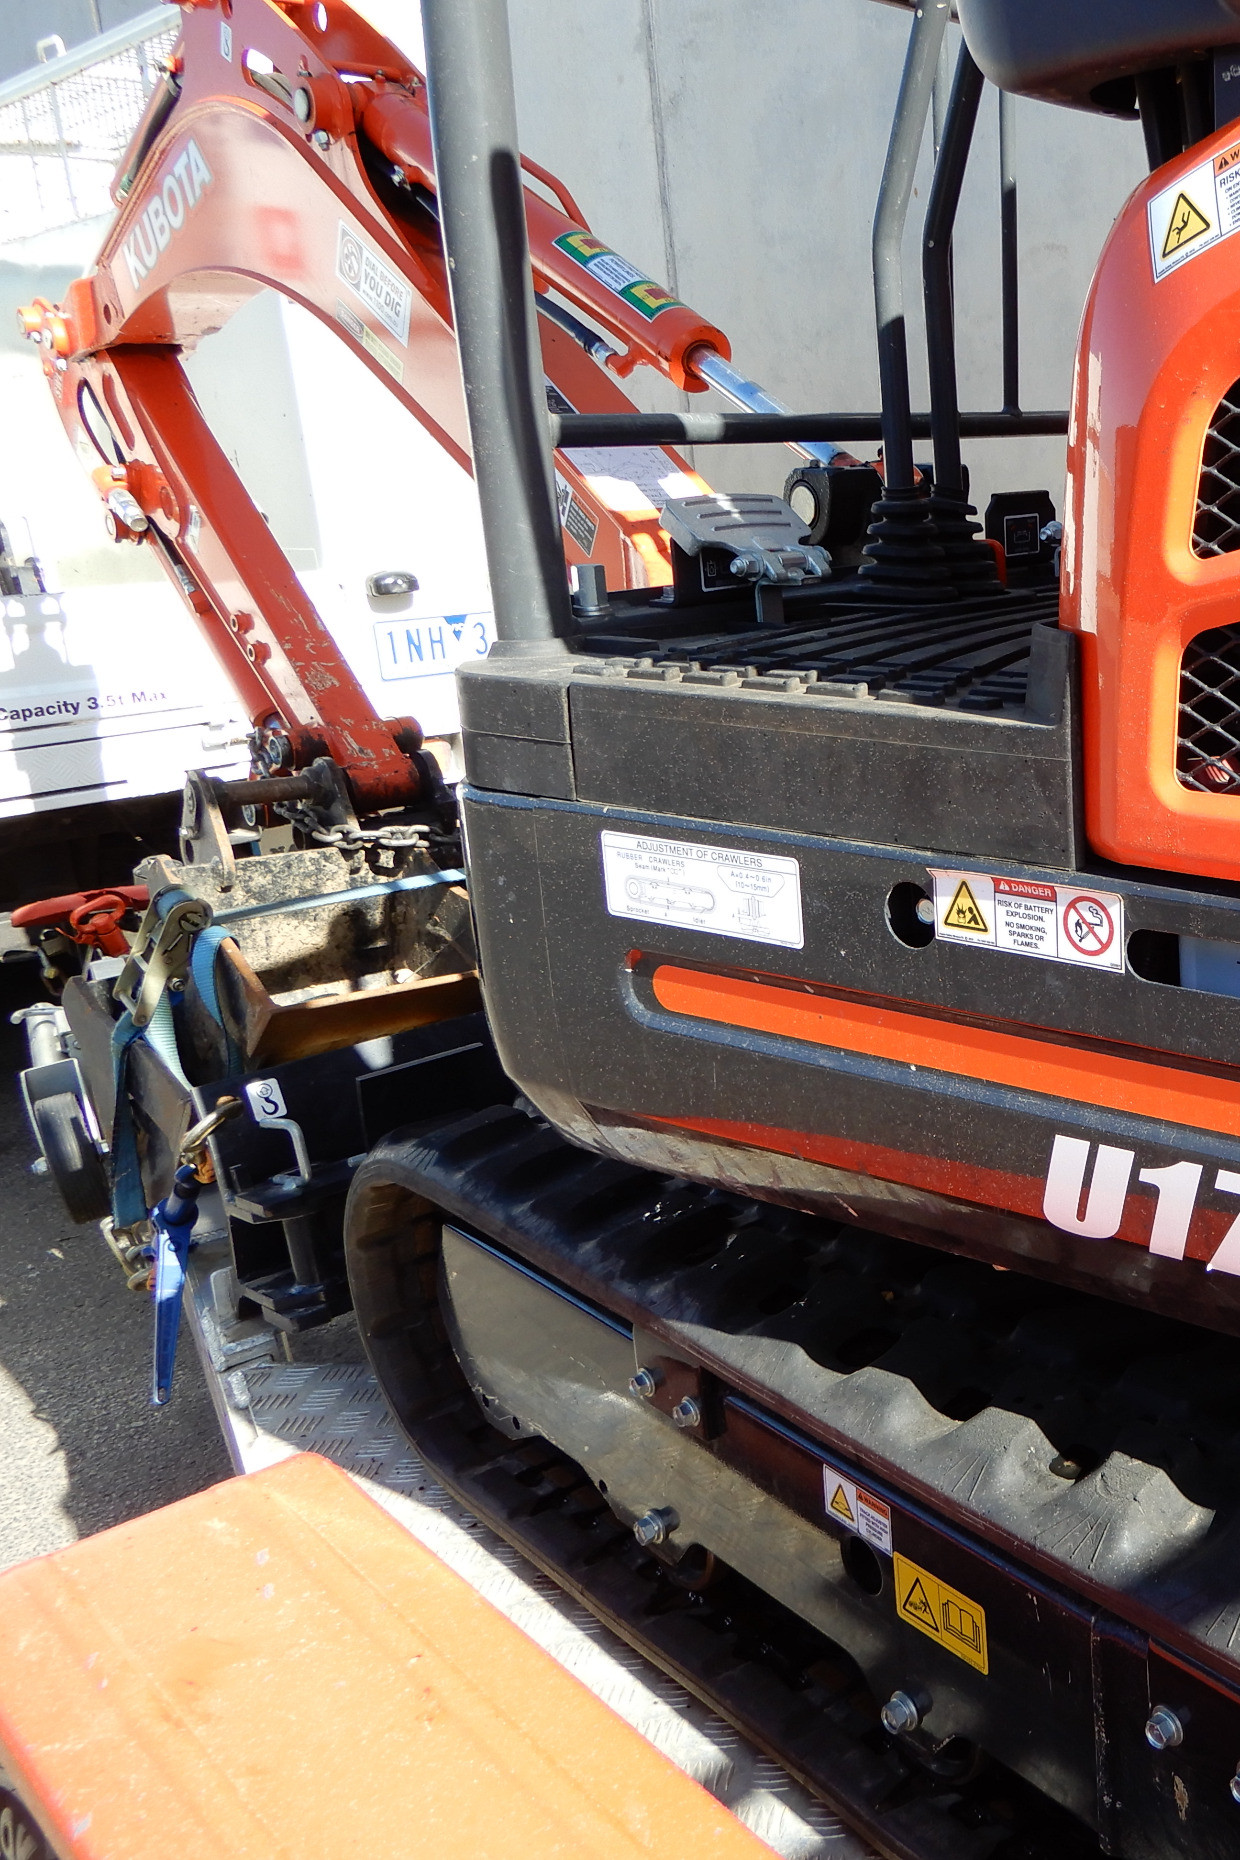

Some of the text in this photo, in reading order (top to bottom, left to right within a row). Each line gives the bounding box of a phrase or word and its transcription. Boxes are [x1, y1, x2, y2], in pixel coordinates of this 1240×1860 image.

[1220, 167, 1240, 188] RISK
[123, 137, 214, 292] KUBOTA
[365, 256, 404, 301] DIAL BEFORE
[364, 269, 402, 318] YOU DIG
[0, 700, 80, 721] Capacity
[616, 851, 685, 868] RUBBER CRAWLERS
[636, 841, 763, 868] ADJUSTMENT OF CRAWLERS
[1010, 883, 1052, 898] DANGER
[997, 899, 1054, 915] RISK OF BATTERY
[1006, 910, 1045, 923] EXPLOSION.
[1005, 921, 1047, 935] NO SMOKING,
[1008, 930, 1044, 942] SPARKS OR
[1013, 939, 1040, 950] FLAMES.
